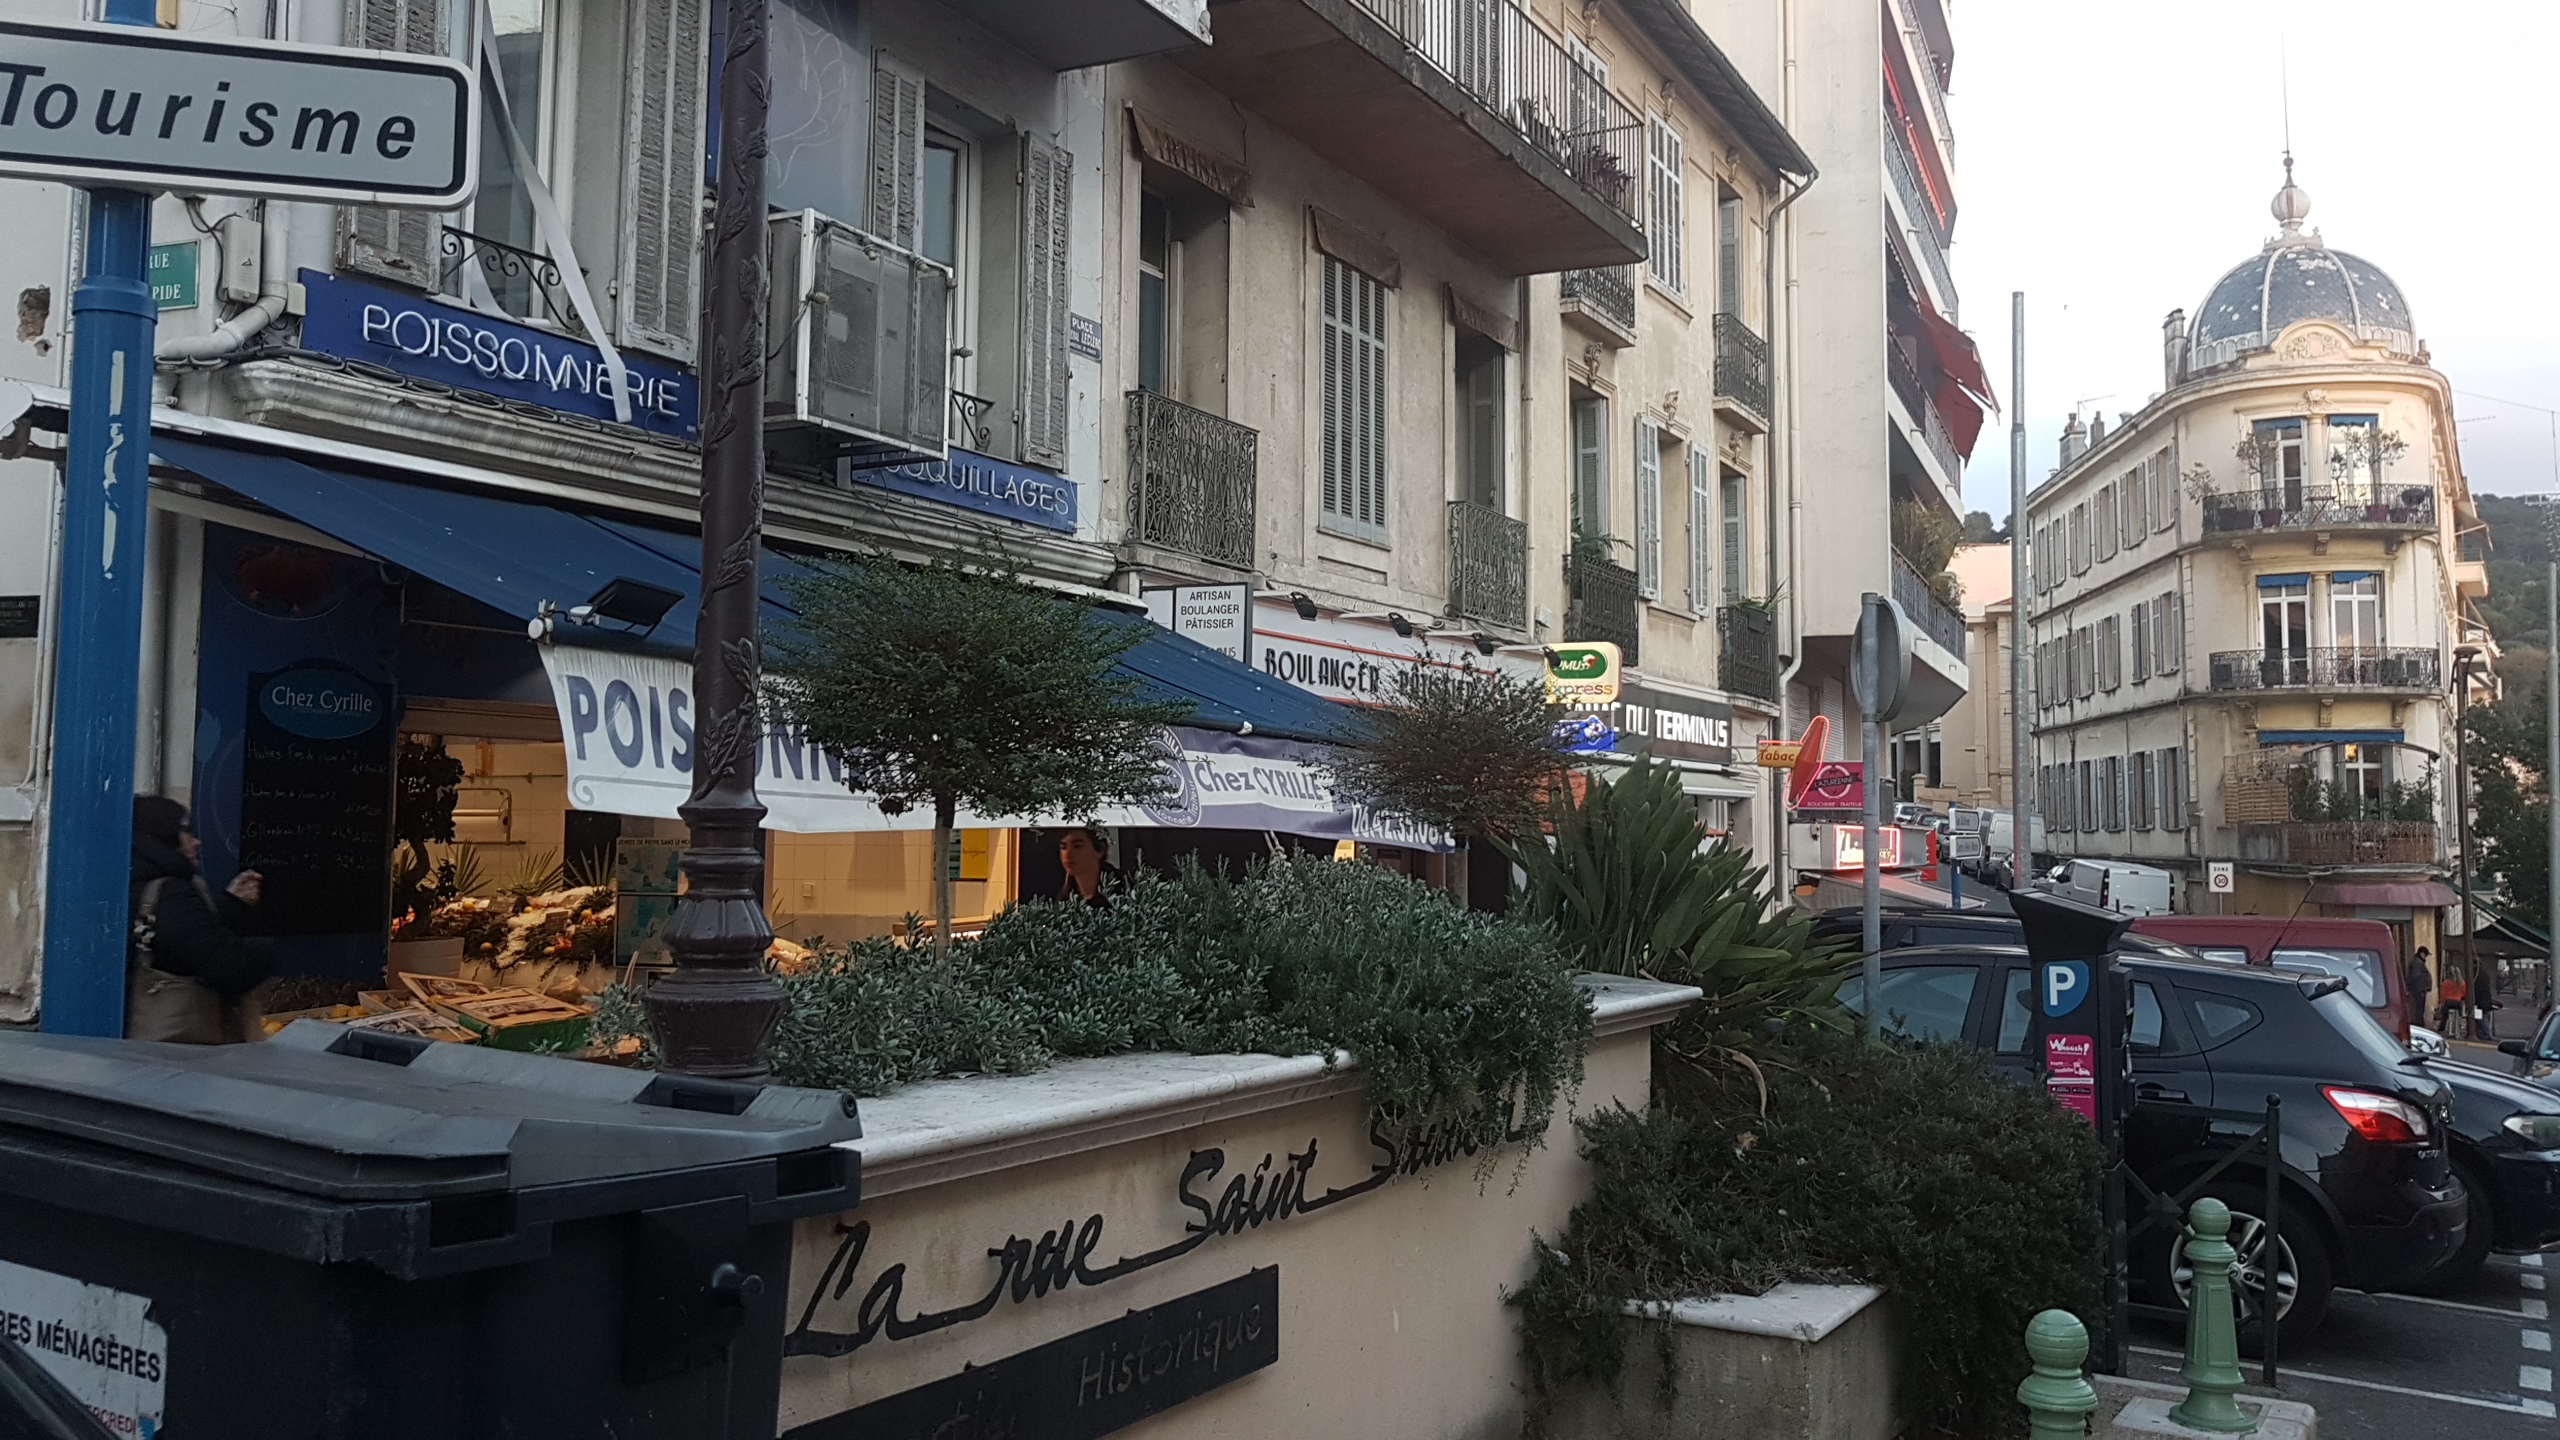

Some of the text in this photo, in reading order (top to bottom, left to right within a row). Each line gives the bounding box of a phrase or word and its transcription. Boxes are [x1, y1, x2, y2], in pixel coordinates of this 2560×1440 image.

[0, 62, 416, 160] Tourisme
[1072, 317, 1094, 335] PLACE
[1181, 604, 1240, 616] BOULANGER
[1189, 590, 1232, 601] ARTISAN
[1185, 617, 1234, 629] PÂTISSIER
[1265, 647, 1379, 693] BOULANGER
[272, 686, 313, 708] Chez
[320, 691, 373, 713] Cyrille
[1546, 683, 1613, 701] xpress
[1625, 703, 1649, 736] DU
[1655, 709, 1728, 747] TERMINUS
[1759, 750, 1795, 762] Tabac
[1195, 762, 1324, 801] Chez CYRILLE
[2050, 965, 2076, 1006] P
[2049, 1037, 2090, 1056] Whoosh!
[784, 1219, 915, 1358] La
[1000, 1214, 1112, 1304] rue
[1178, 1137, 1320, 1236] Saint
[36, 1319, 161, 1383] MÉNAGÈRES
[1077, 1304, 1262, 1408] Historique
